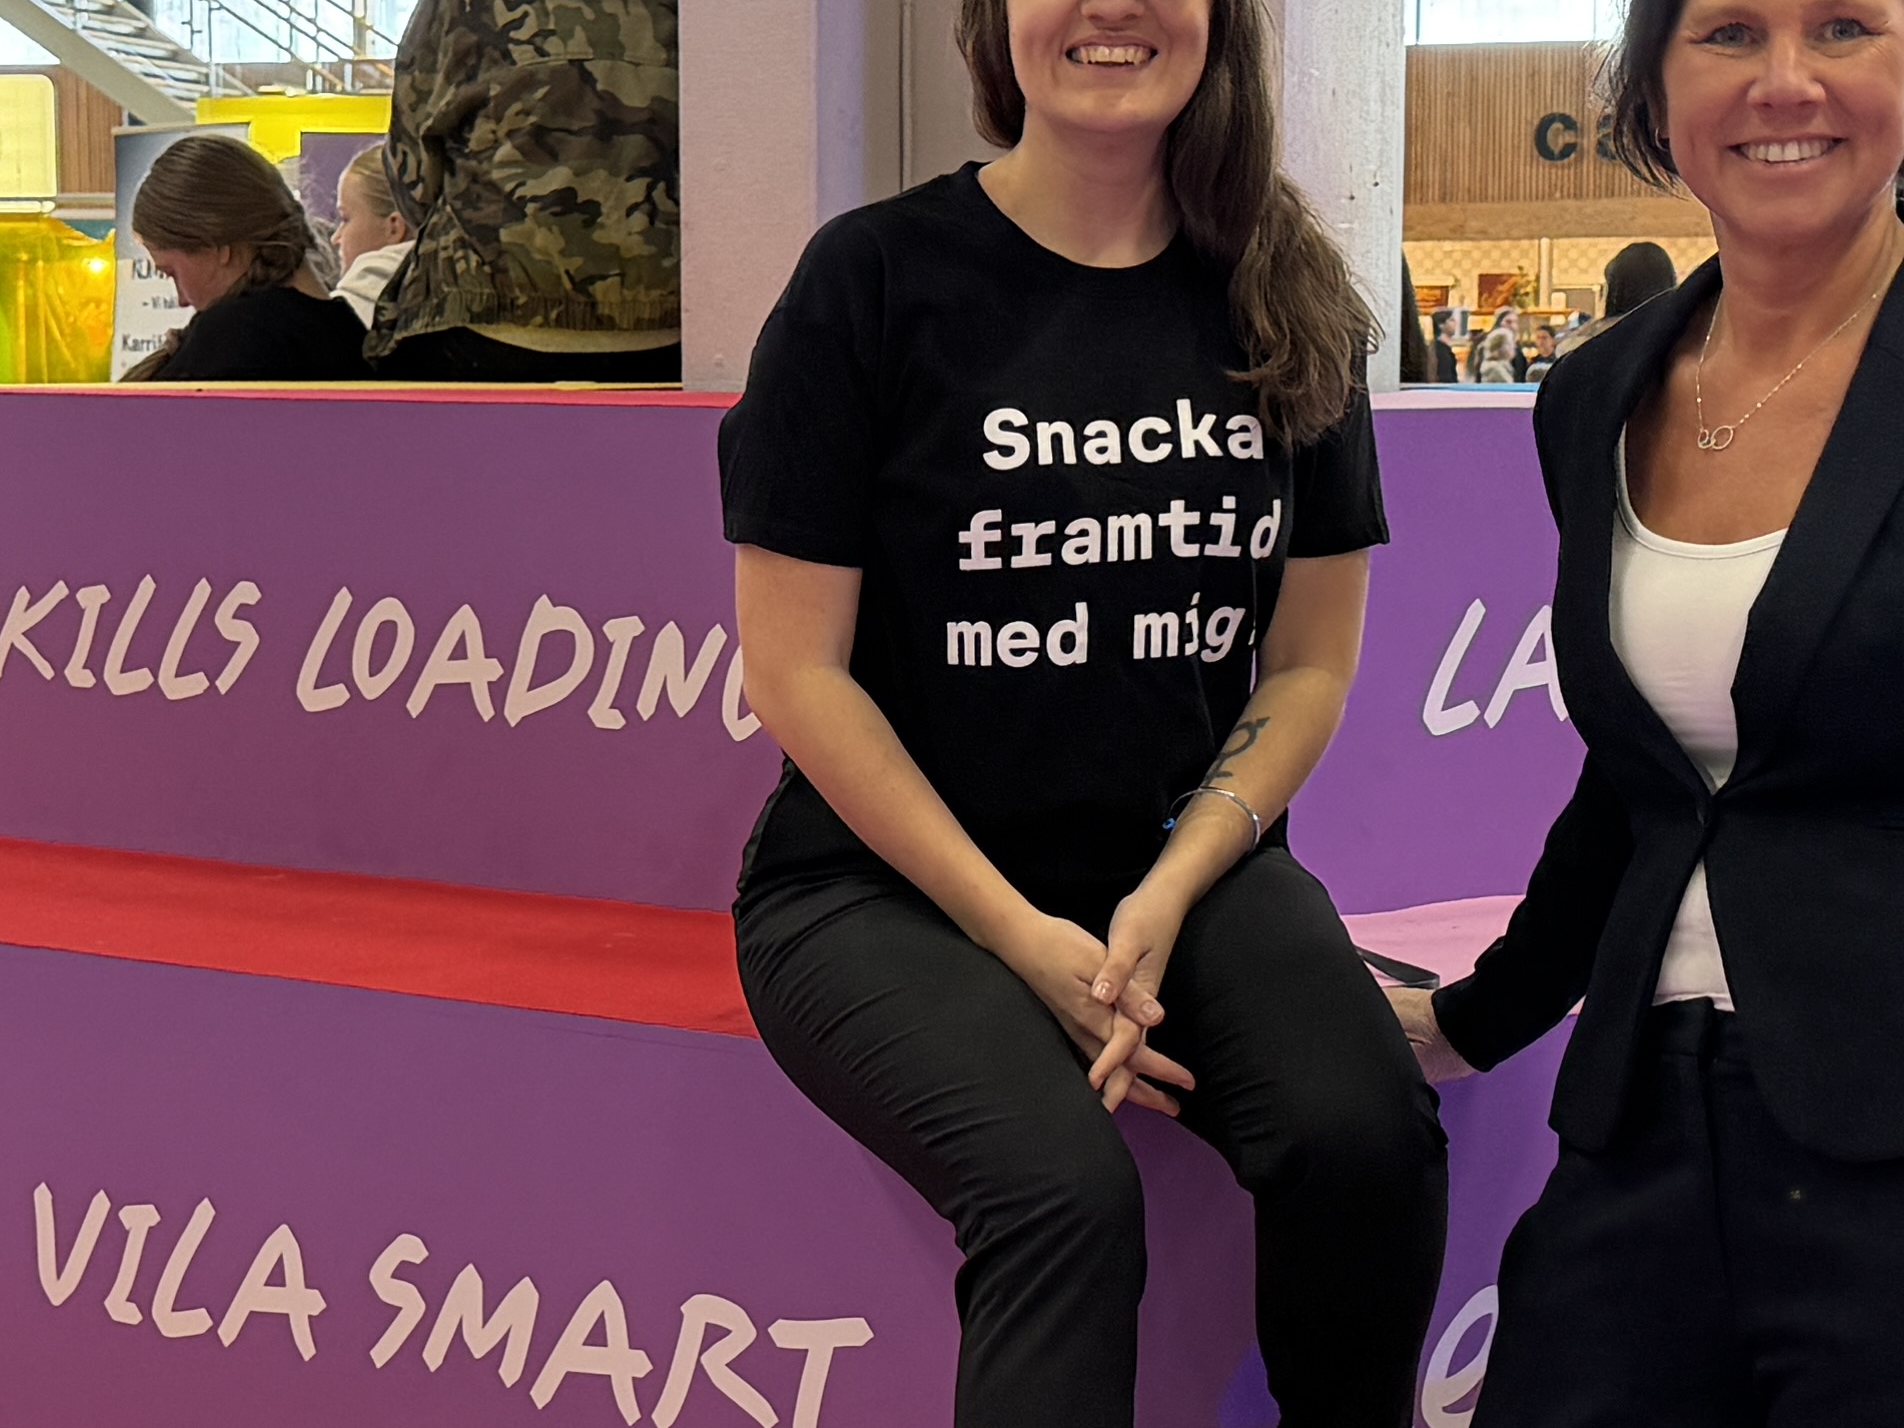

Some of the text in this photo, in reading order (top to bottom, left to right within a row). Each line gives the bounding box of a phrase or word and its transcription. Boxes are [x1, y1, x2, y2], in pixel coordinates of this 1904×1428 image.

[982, 398, 1264, 471] Snacka
[958, 496, 1282, 571] framtid
[946, 602, 1089, 668] med
[33, 1180, 326, 1361] VILA
